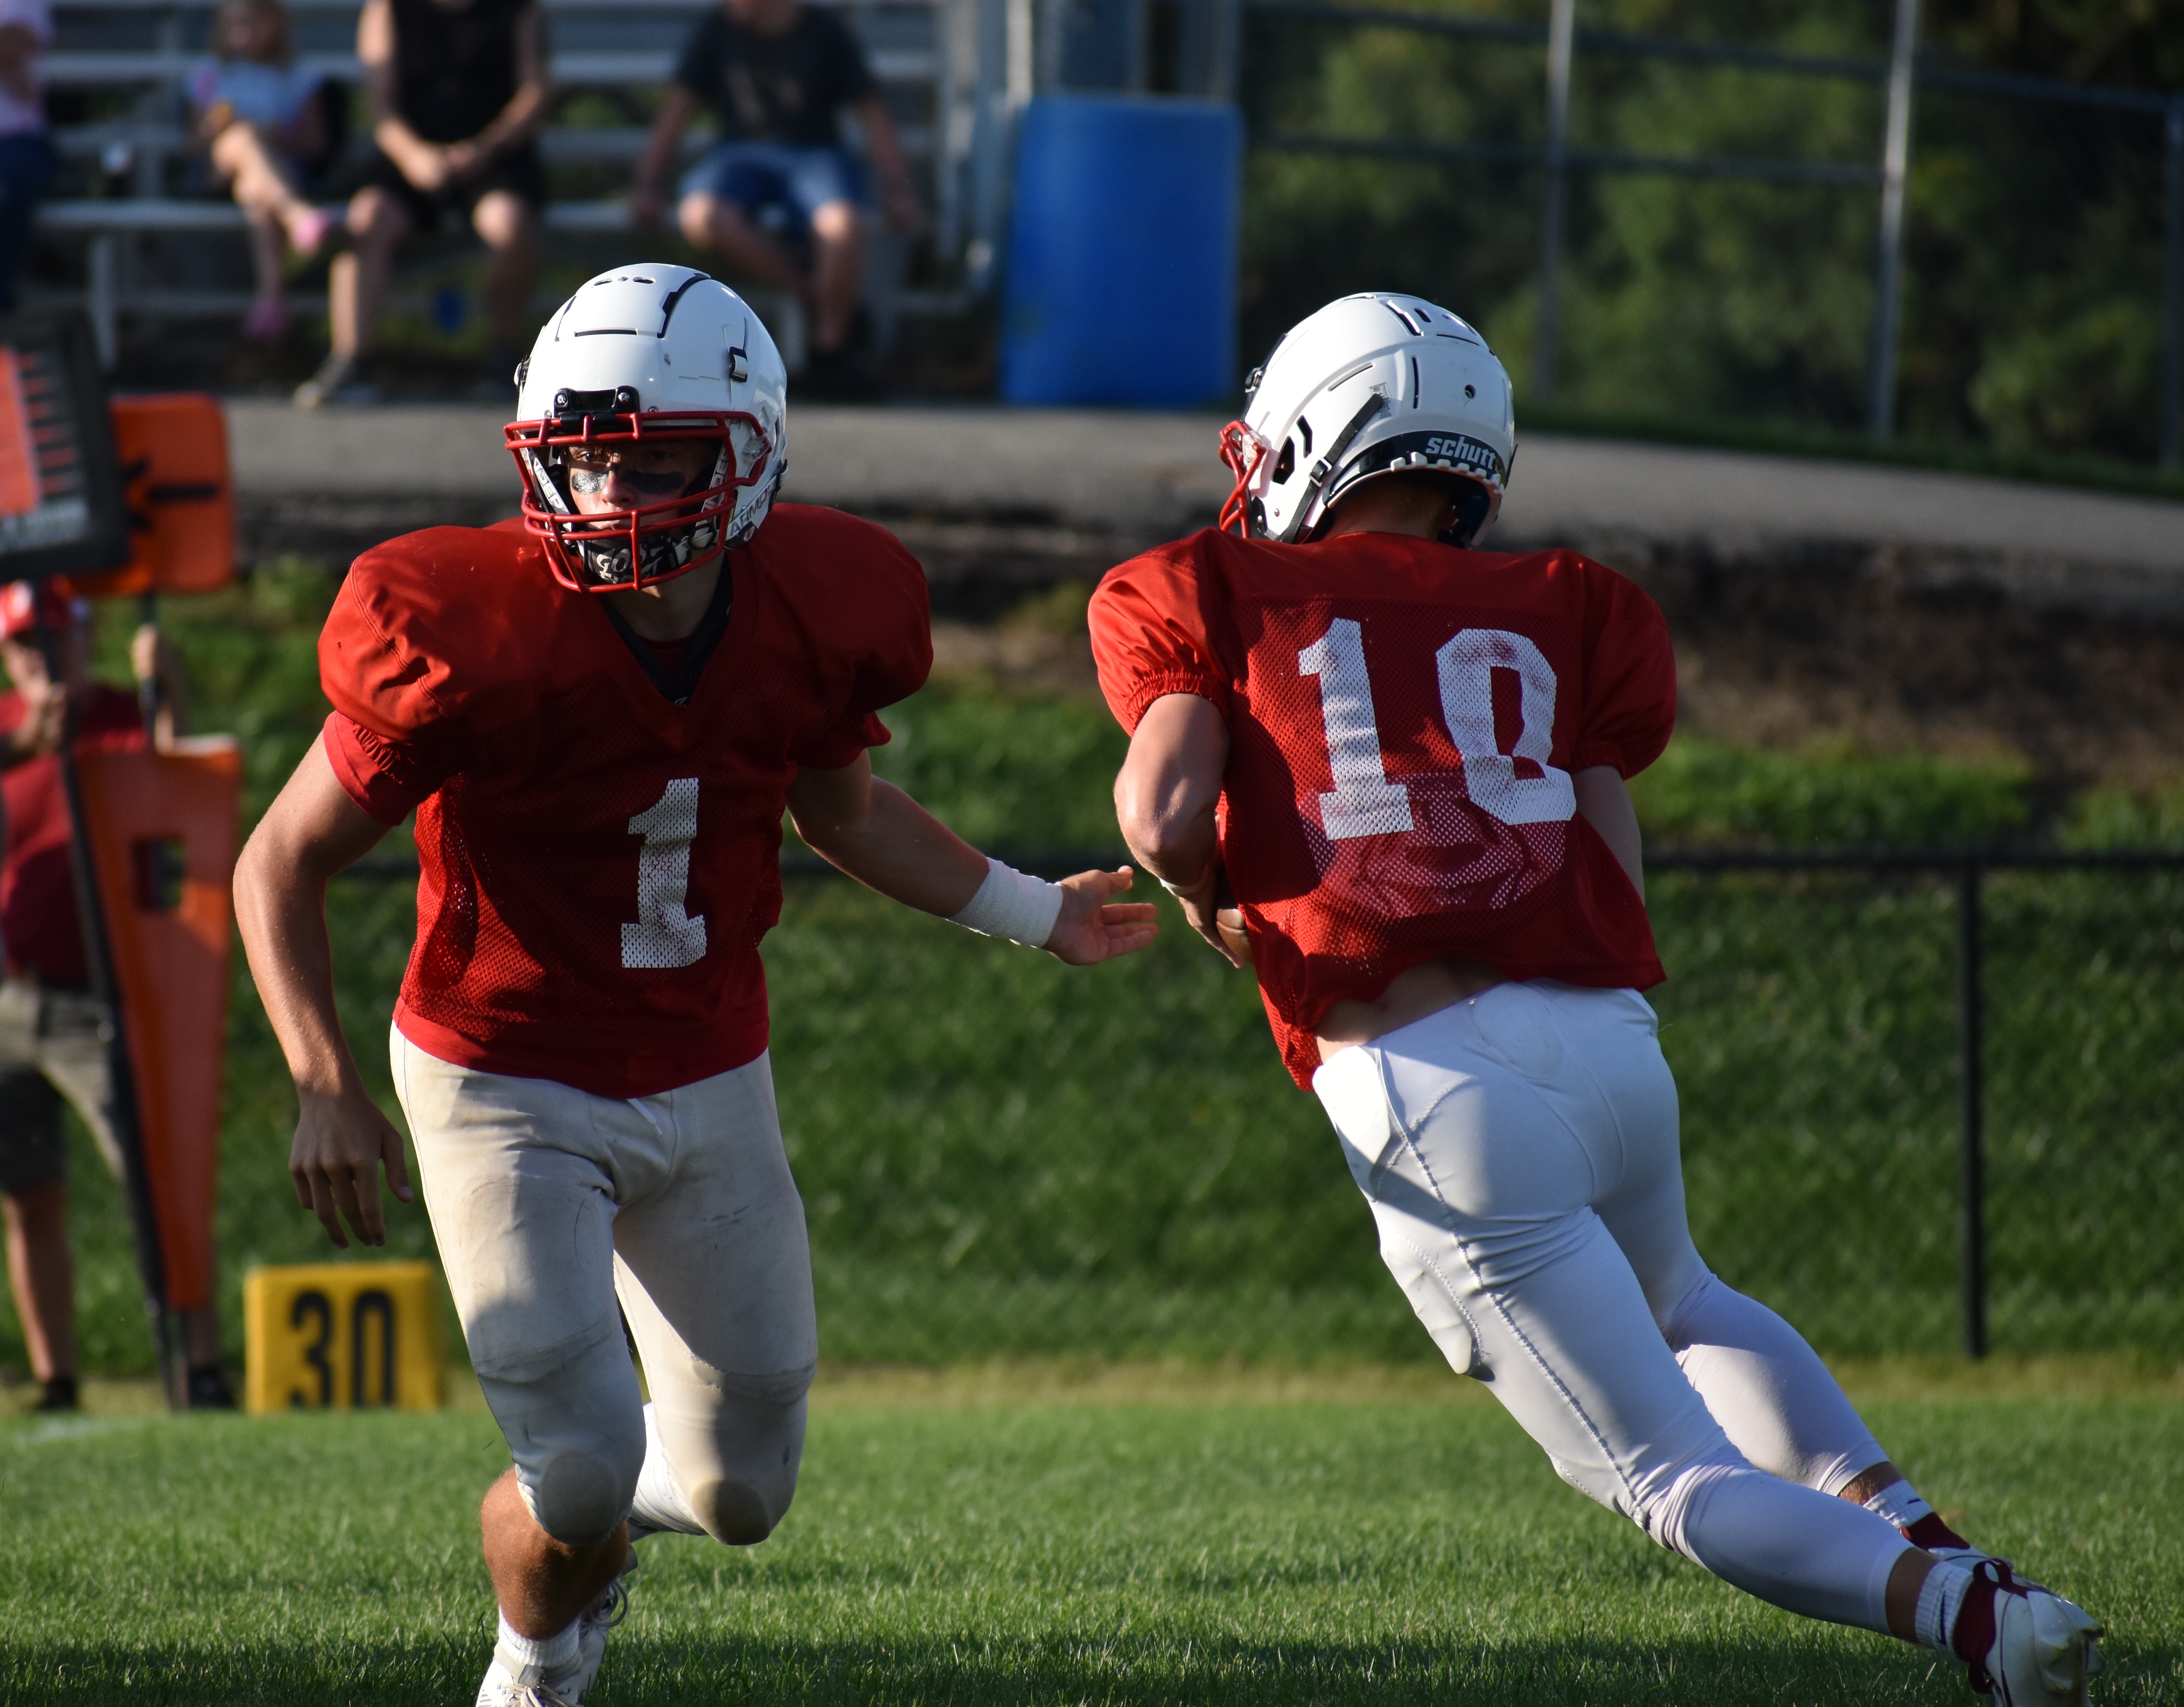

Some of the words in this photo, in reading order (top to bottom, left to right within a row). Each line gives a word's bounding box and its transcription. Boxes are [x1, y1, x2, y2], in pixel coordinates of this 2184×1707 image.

[1425, 436, 1496, 469] schutt
[621, 777, 707, 968] 1
[291, 1289, 396, 1409] 30
